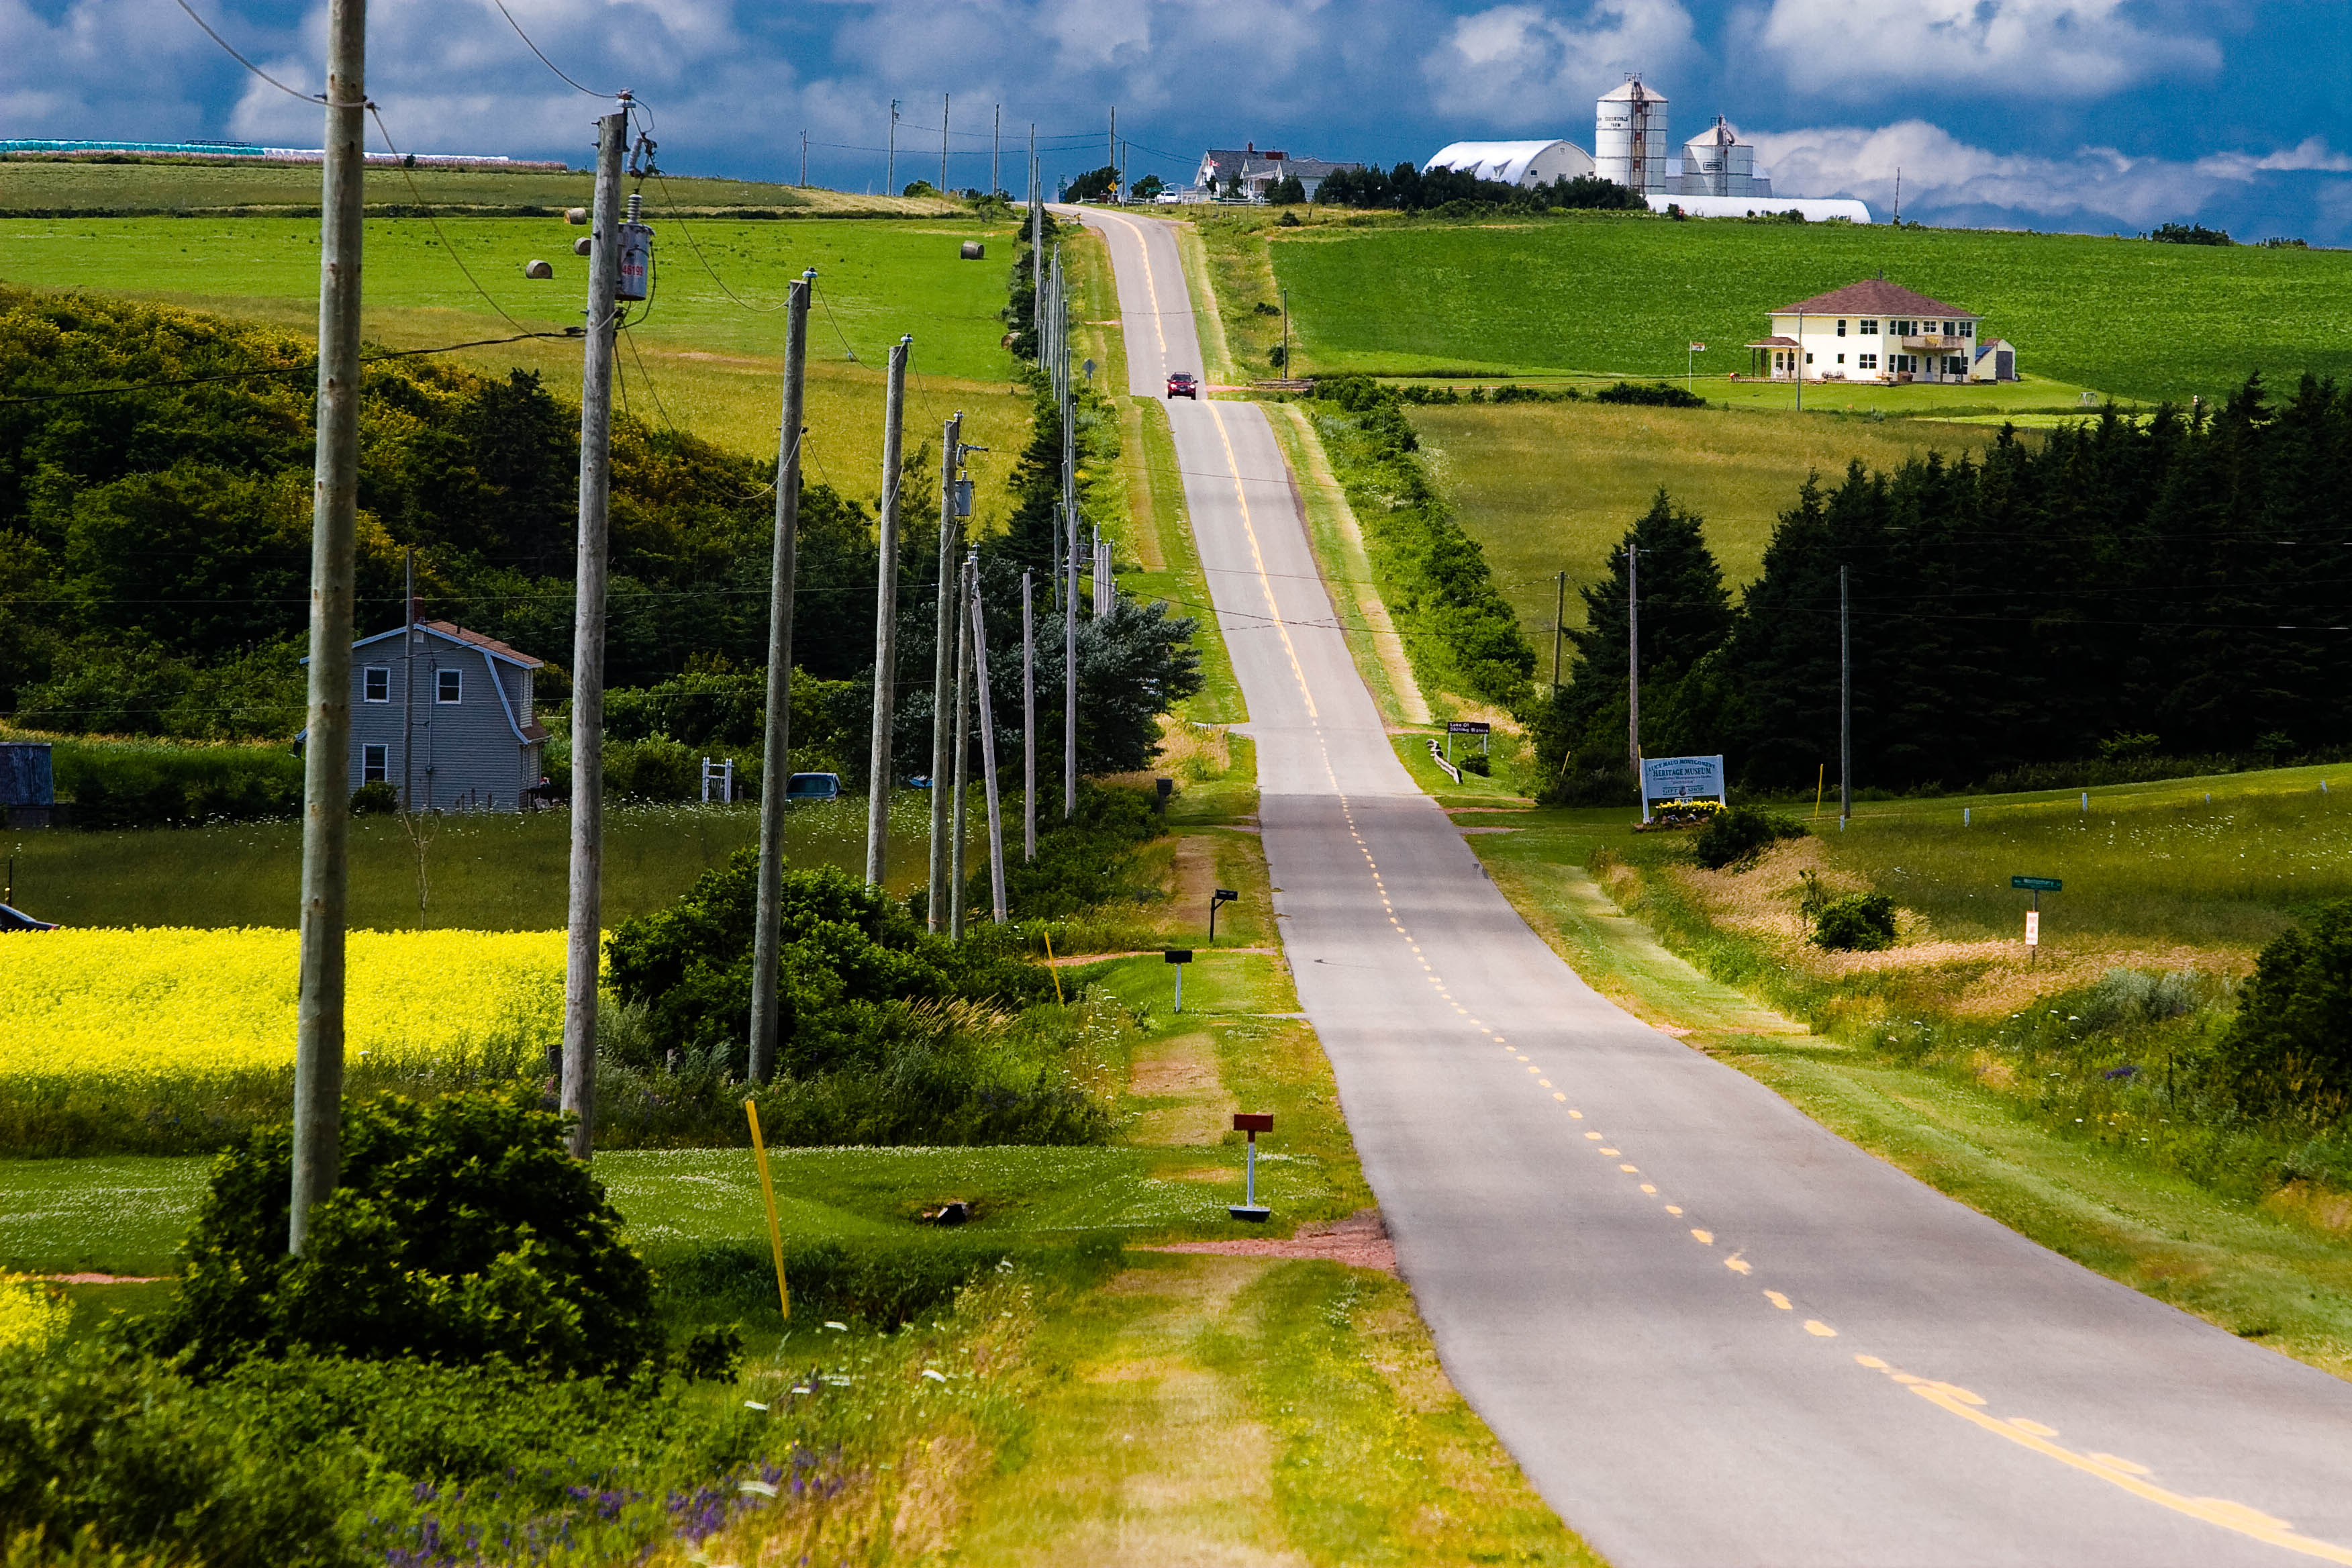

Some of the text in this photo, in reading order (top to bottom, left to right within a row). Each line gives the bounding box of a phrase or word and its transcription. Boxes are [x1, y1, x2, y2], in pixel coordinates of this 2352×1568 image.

[1663, 759, 1678, 768] MAUD
[1679, 759, 1716, 769] MONTGOMERY
[1653, 767, 1712, 777] HERITAGE MUSEUM
